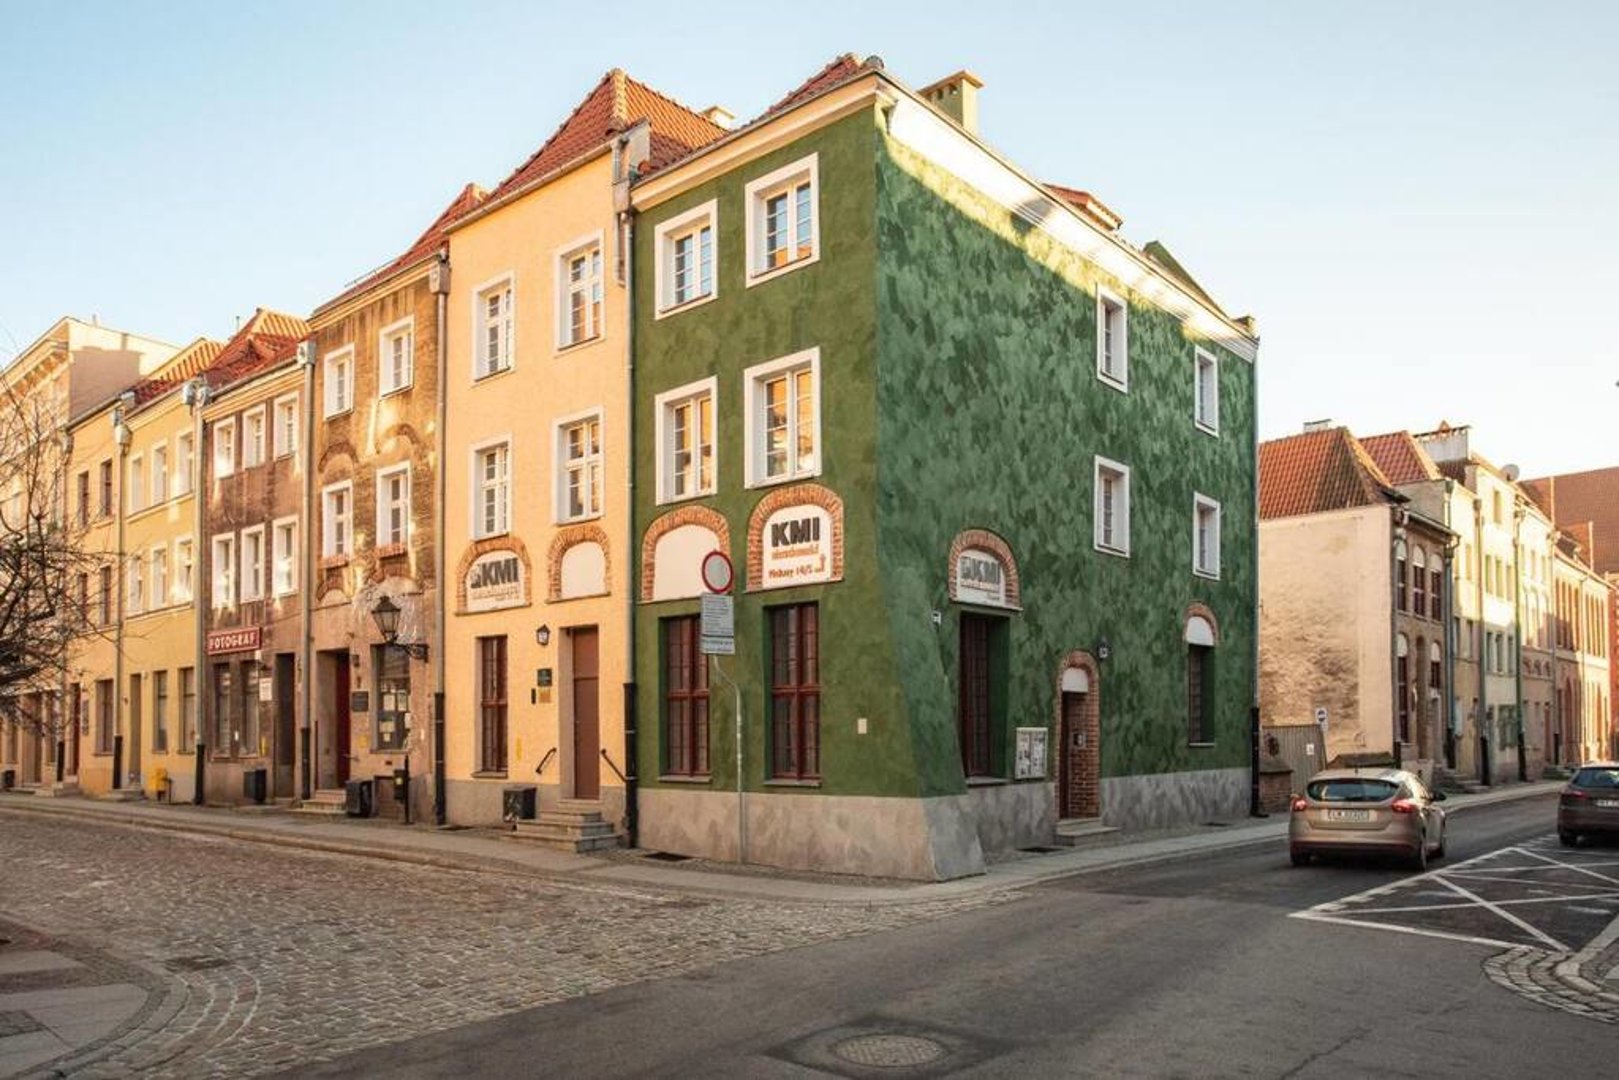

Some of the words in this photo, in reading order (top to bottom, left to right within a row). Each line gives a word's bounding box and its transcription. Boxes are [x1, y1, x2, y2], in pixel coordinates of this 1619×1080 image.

[771, 517, 820, 548] KMI
[481, 557, 518, 588] KMI
[971, 558, 1001, 585] KMI
[209, 632, 257, 650] FOTOGRAF
